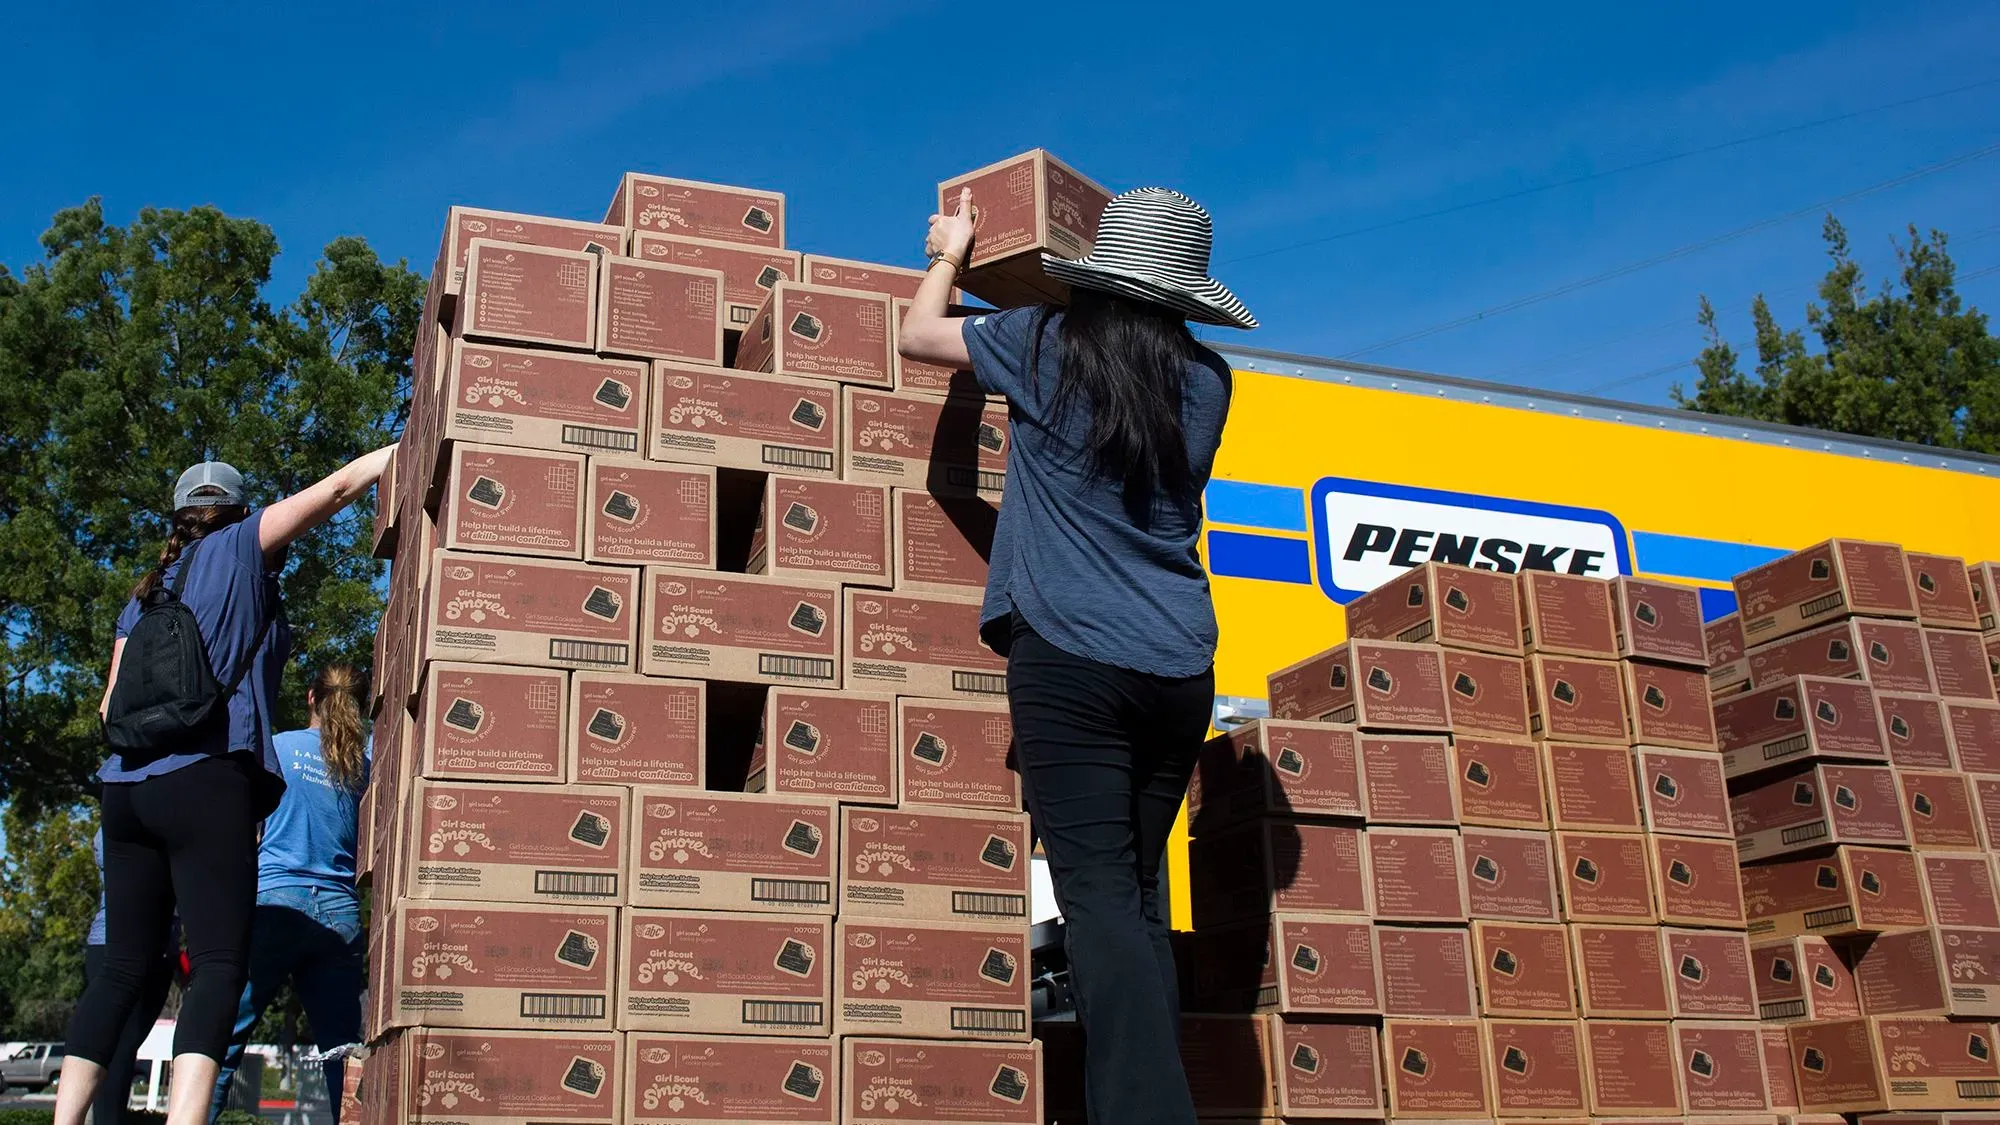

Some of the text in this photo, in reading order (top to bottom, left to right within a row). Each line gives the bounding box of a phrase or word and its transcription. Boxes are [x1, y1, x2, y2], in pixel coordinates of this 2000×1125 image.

[998, 227, 1024, 241] lifetime
[976, 246, 989, 257] and
[786, 351, 804, 360] Help
[820, 354, 838, 362] build
[846, 357, 874, 367] lifetime
[796, 361, 819, 369] skills
[821, 364, 835, 372] and
[696, 399, 718, 408] Scout
[606, 521, 618, 532] Girl
[618, 525, 635, 533] Scout
[598, 535, 618, 544] Help
[619, 536, 632, 544] her
[635, 537, 655, 546] build
[663, 540, 696, 549] lifetime
[608, 545, 634, 555] skills
[1343, 523, 1605, 576] PENSKE
[602, 576, 628, 584] 007029
[458, 589, 501, 599] Girl Scout
[887, 624, 908, 633] Scout
[447, 732, 459, 742] Girl
[460, 736, 479, 744] Scout
[438, 747, 459, 757] Help
[478, 749, 500, 757] build
[509, 751, 543, 759] lifetime
[449, 758, 476, 769] skills
[908, 779, 927, 789] Help
[928, 780, 942, 788] her
[944, 780, 963, 790] build
[971, 782, 1002, 791] lifetime
[909, 790, 917, 798] of
[919, 789, 944, 799] skills
[441, 820, 486, 829] Girl Scout
[866, 842, 905, 851] Girl Scout
[577, 918, 605, 926] 007029
[423, 943, 468, 952] Girl Scout
[650, 950, 693, 959] Girl Scout
[428, 1071, 475, 1080] Girl Scout
[656, 1075, 672, 1083] Girl
[872, 1077, 912, 1086] Girl Scout
